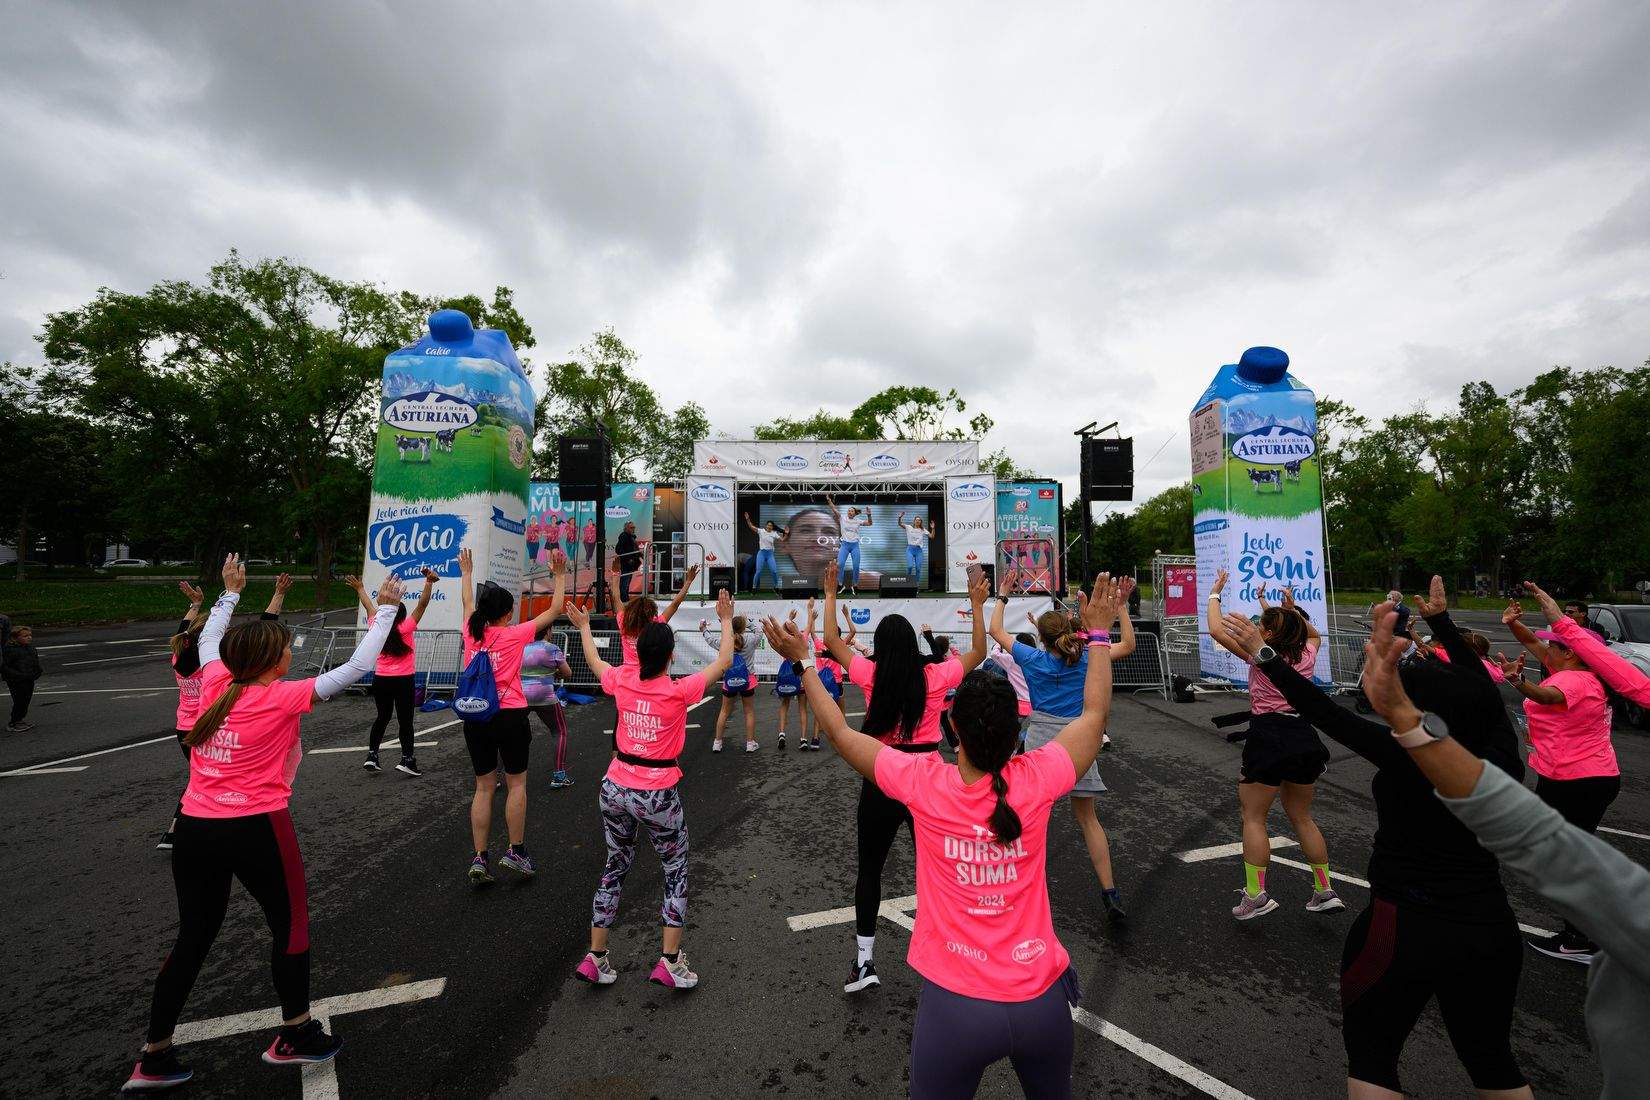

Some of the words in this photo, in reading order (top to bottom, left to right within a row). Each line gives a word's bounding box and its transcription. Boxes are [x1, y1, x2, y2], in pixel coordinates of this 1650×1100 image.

[737, 459, 766, 467] OYSHO
[945, 458, 974, 466] OYSHO
[376, 508, 399, 521] Leche
[400, 505, 418, 516] rica
[421, 504, 433, 513] en
[693, 522, 729, 531] OYSHO
[953, 520, 990, 530] OYSHO
[998, 521, 1039, 532] UJER
[374, 522, 455, 560] Calcio
[1241, 532, 1285, 556] Leche
[636, 699, 651, 715] TU
[623, 711, 664, 729] DORSAL
[627, 726, 657, 742] SUMA
[944, 835, 1028, 863] DORSAL
[956, 862, 1018, 886] SUMA
[977, 895, 1006, 907] 2024
[946, 941, 988, 962] OYSHO
